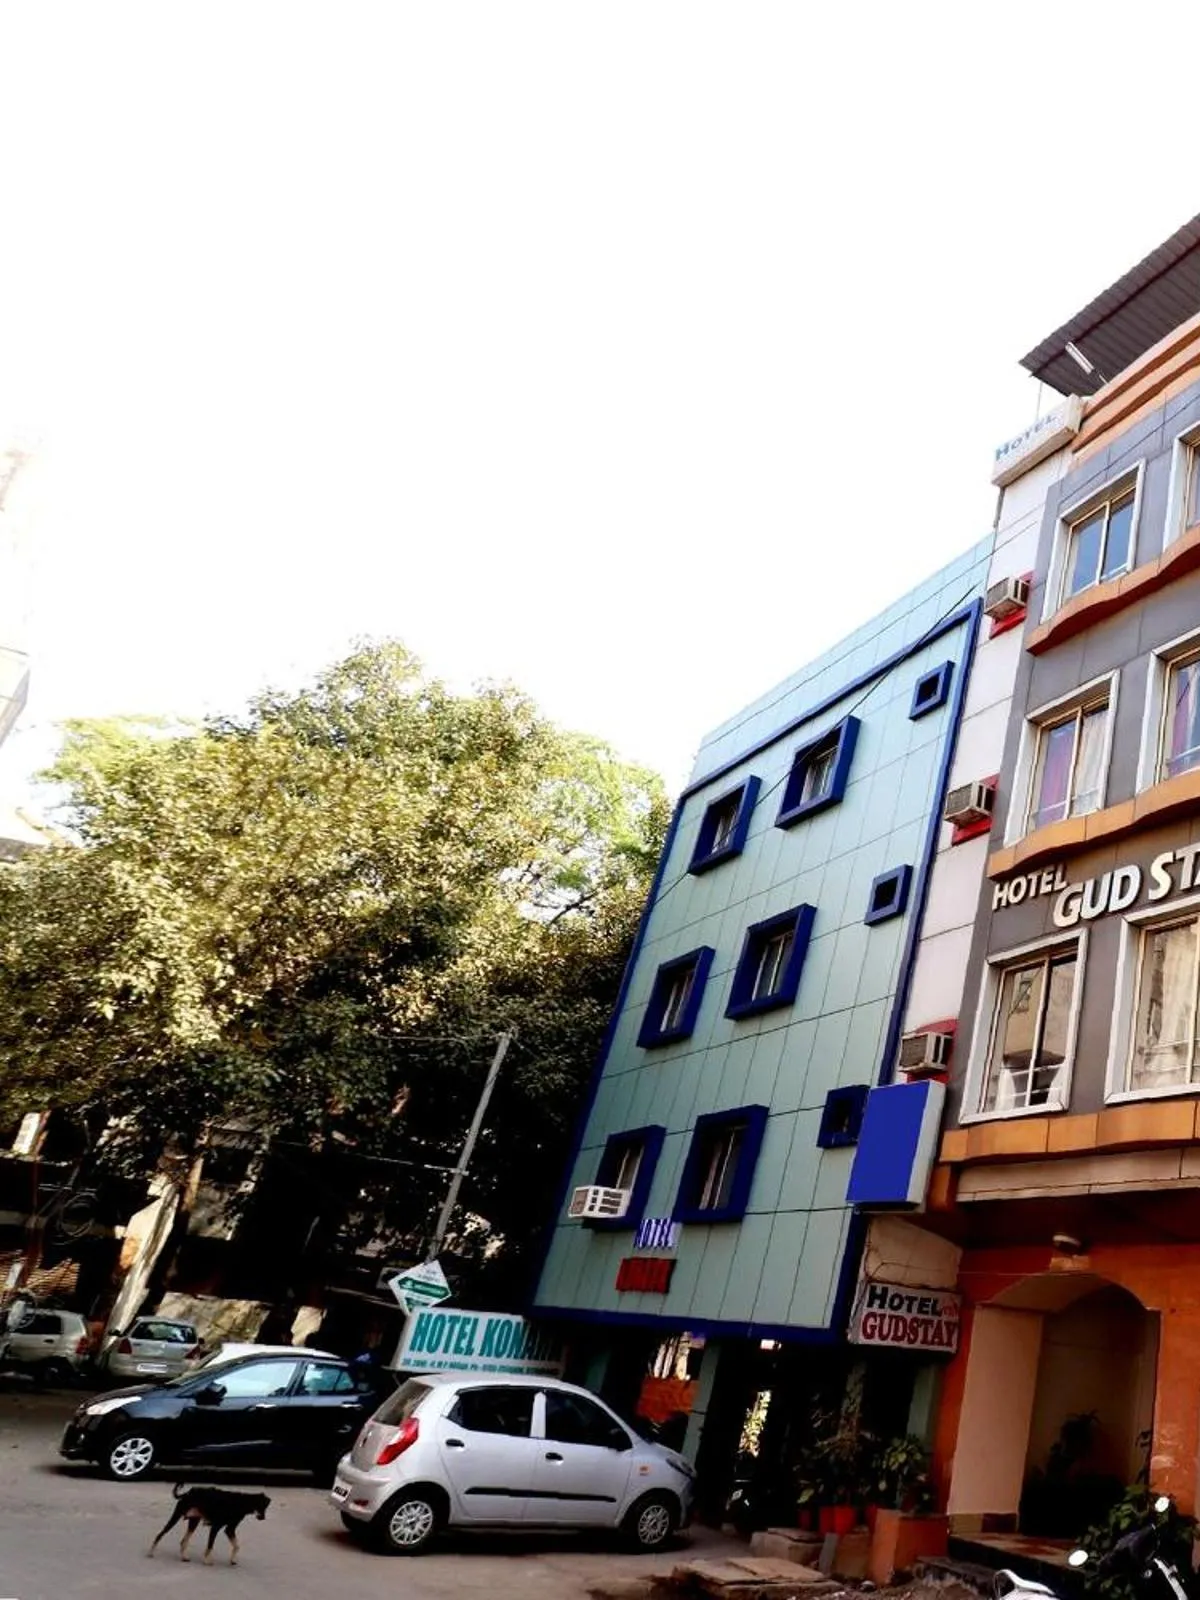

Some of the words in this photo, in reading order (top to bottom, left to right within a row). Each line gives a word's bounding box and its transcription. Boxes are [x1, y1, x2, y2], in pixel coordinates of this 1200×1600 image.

[992, 862, 1067, 911] HOTEL
[1053, 865, 1141, 927] GUD
[866, 1285, 941, 1317] HOTEL
[410, 1312, 479, 1356] HOTEL
